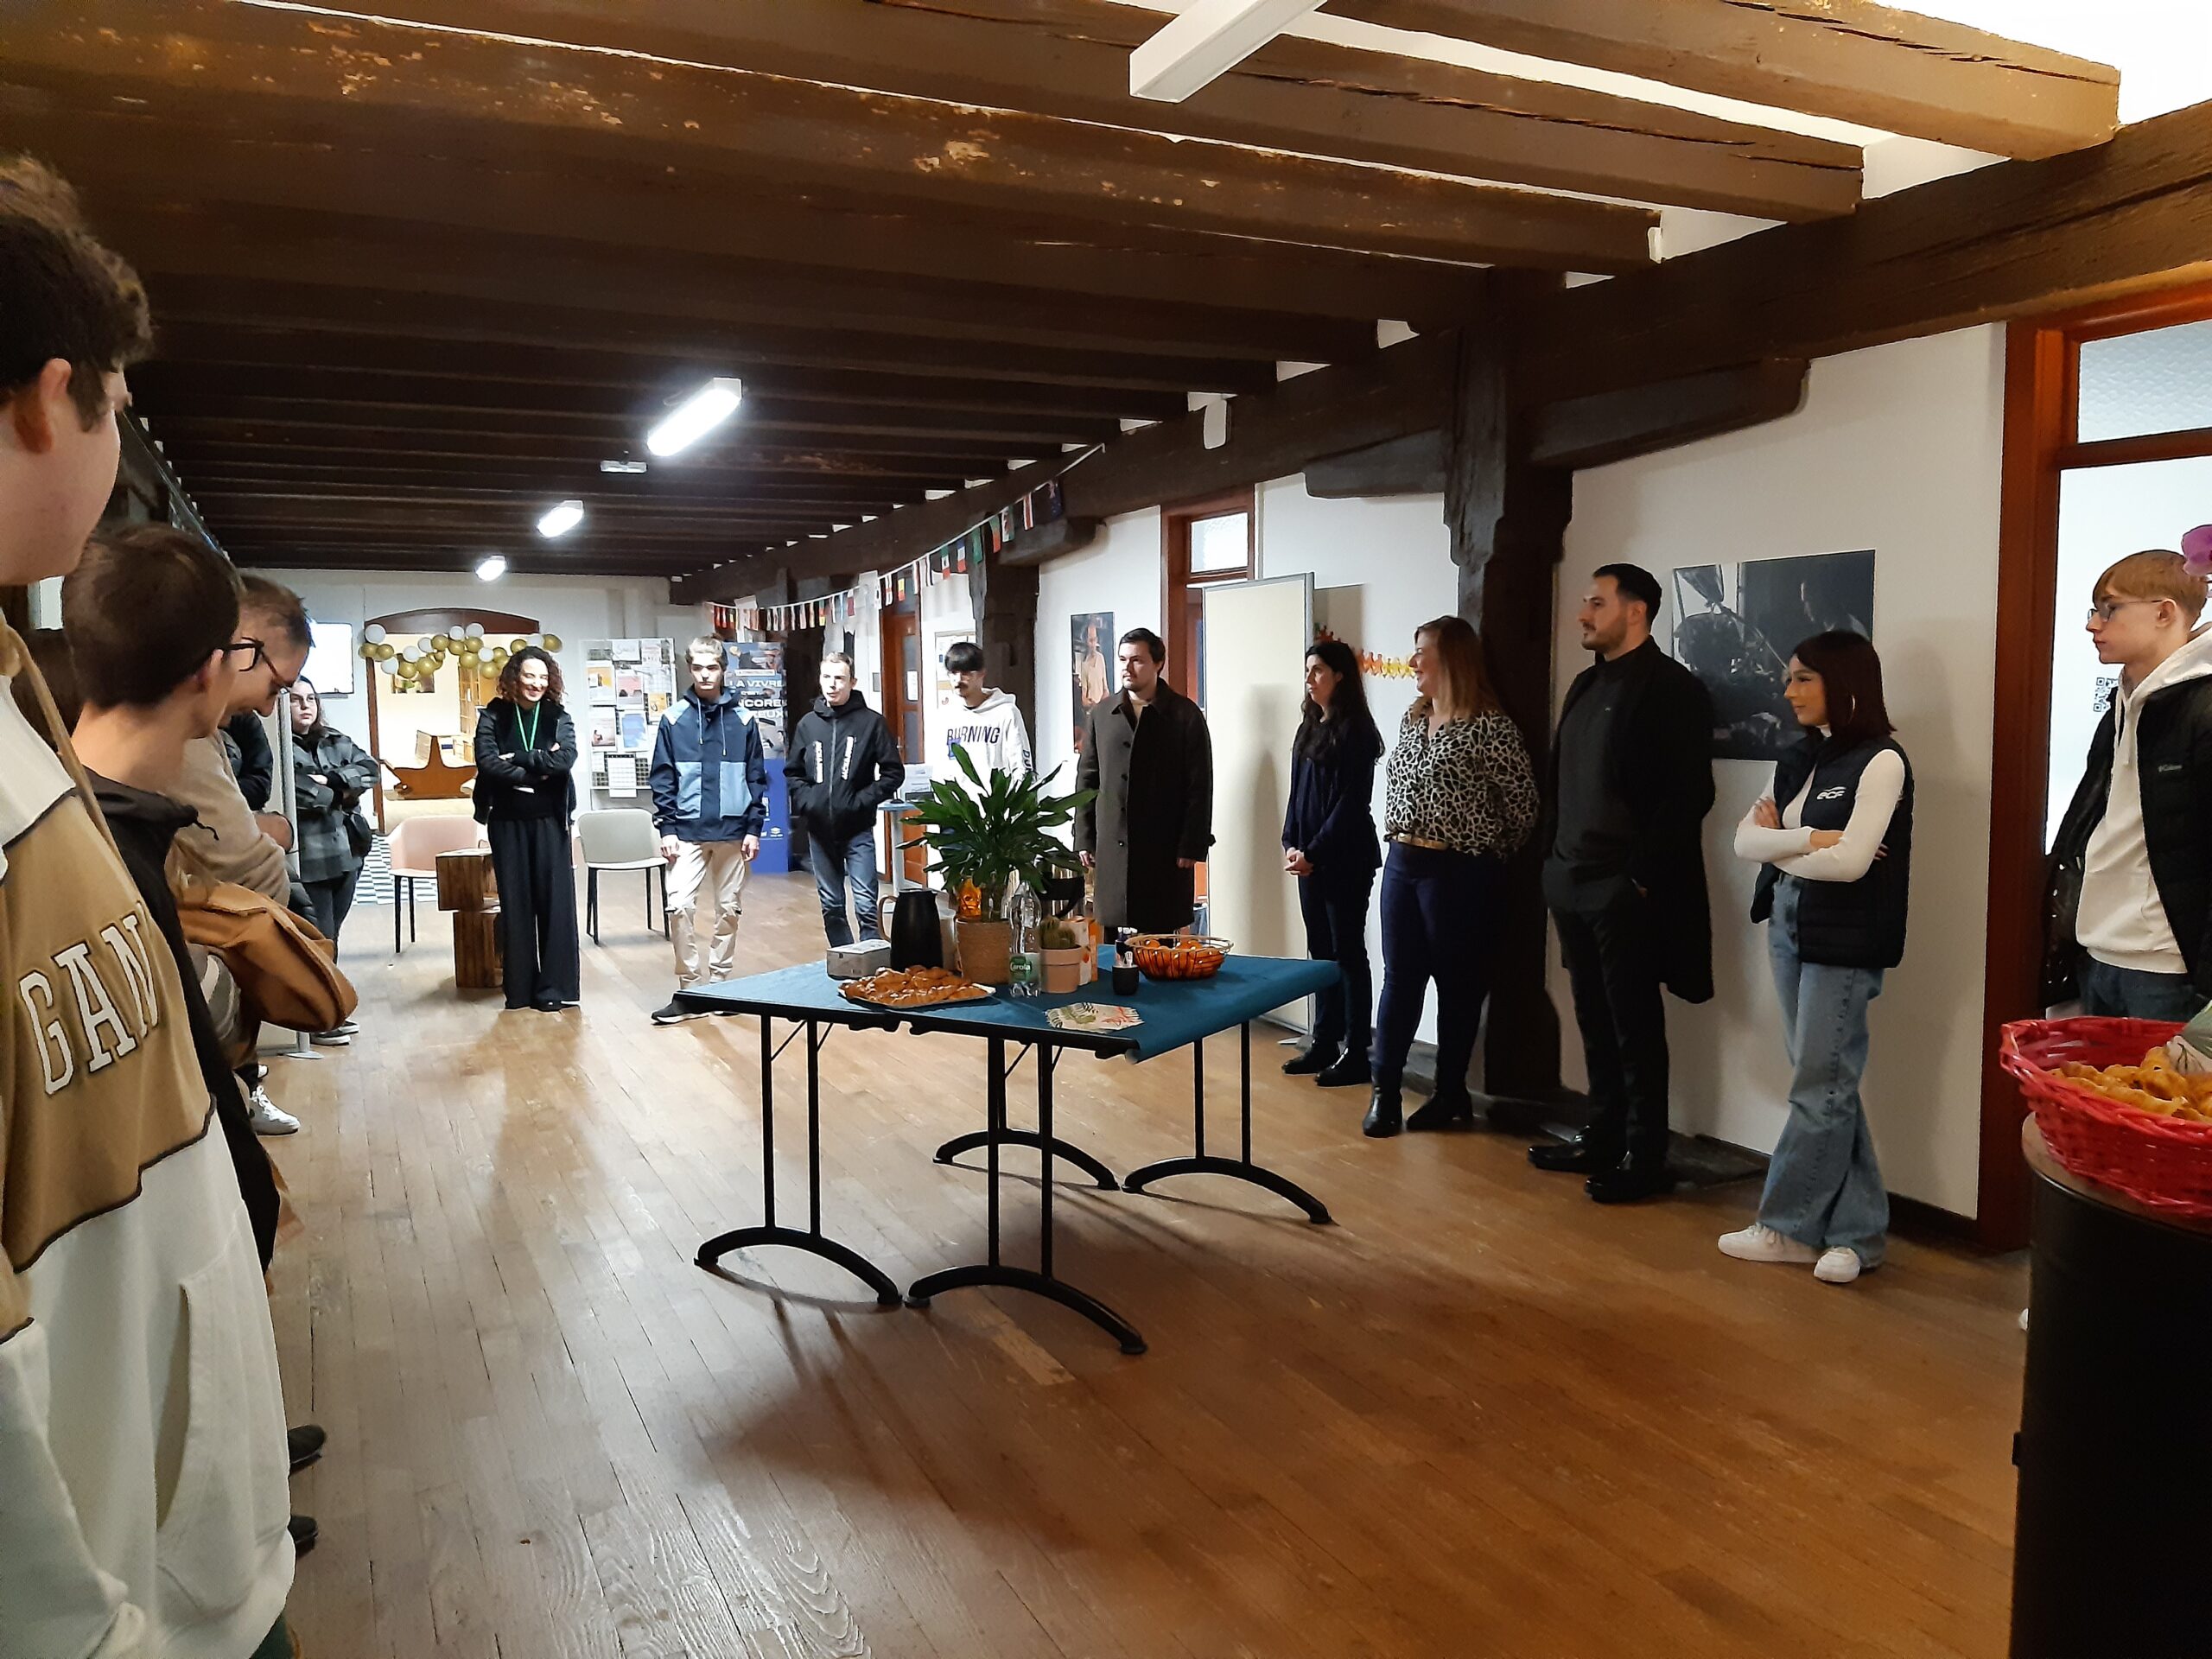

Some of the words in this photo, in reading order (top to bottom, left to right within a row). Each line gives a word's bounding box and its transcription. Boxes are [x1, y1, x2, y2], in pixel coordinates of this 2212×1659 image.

[747, 679, 783, 688] VIVRE
[738, 698, 782, 708] NCORE
[946, 725, 1001, 746] BURNING
[19, 901, 159, 1096] GAN
